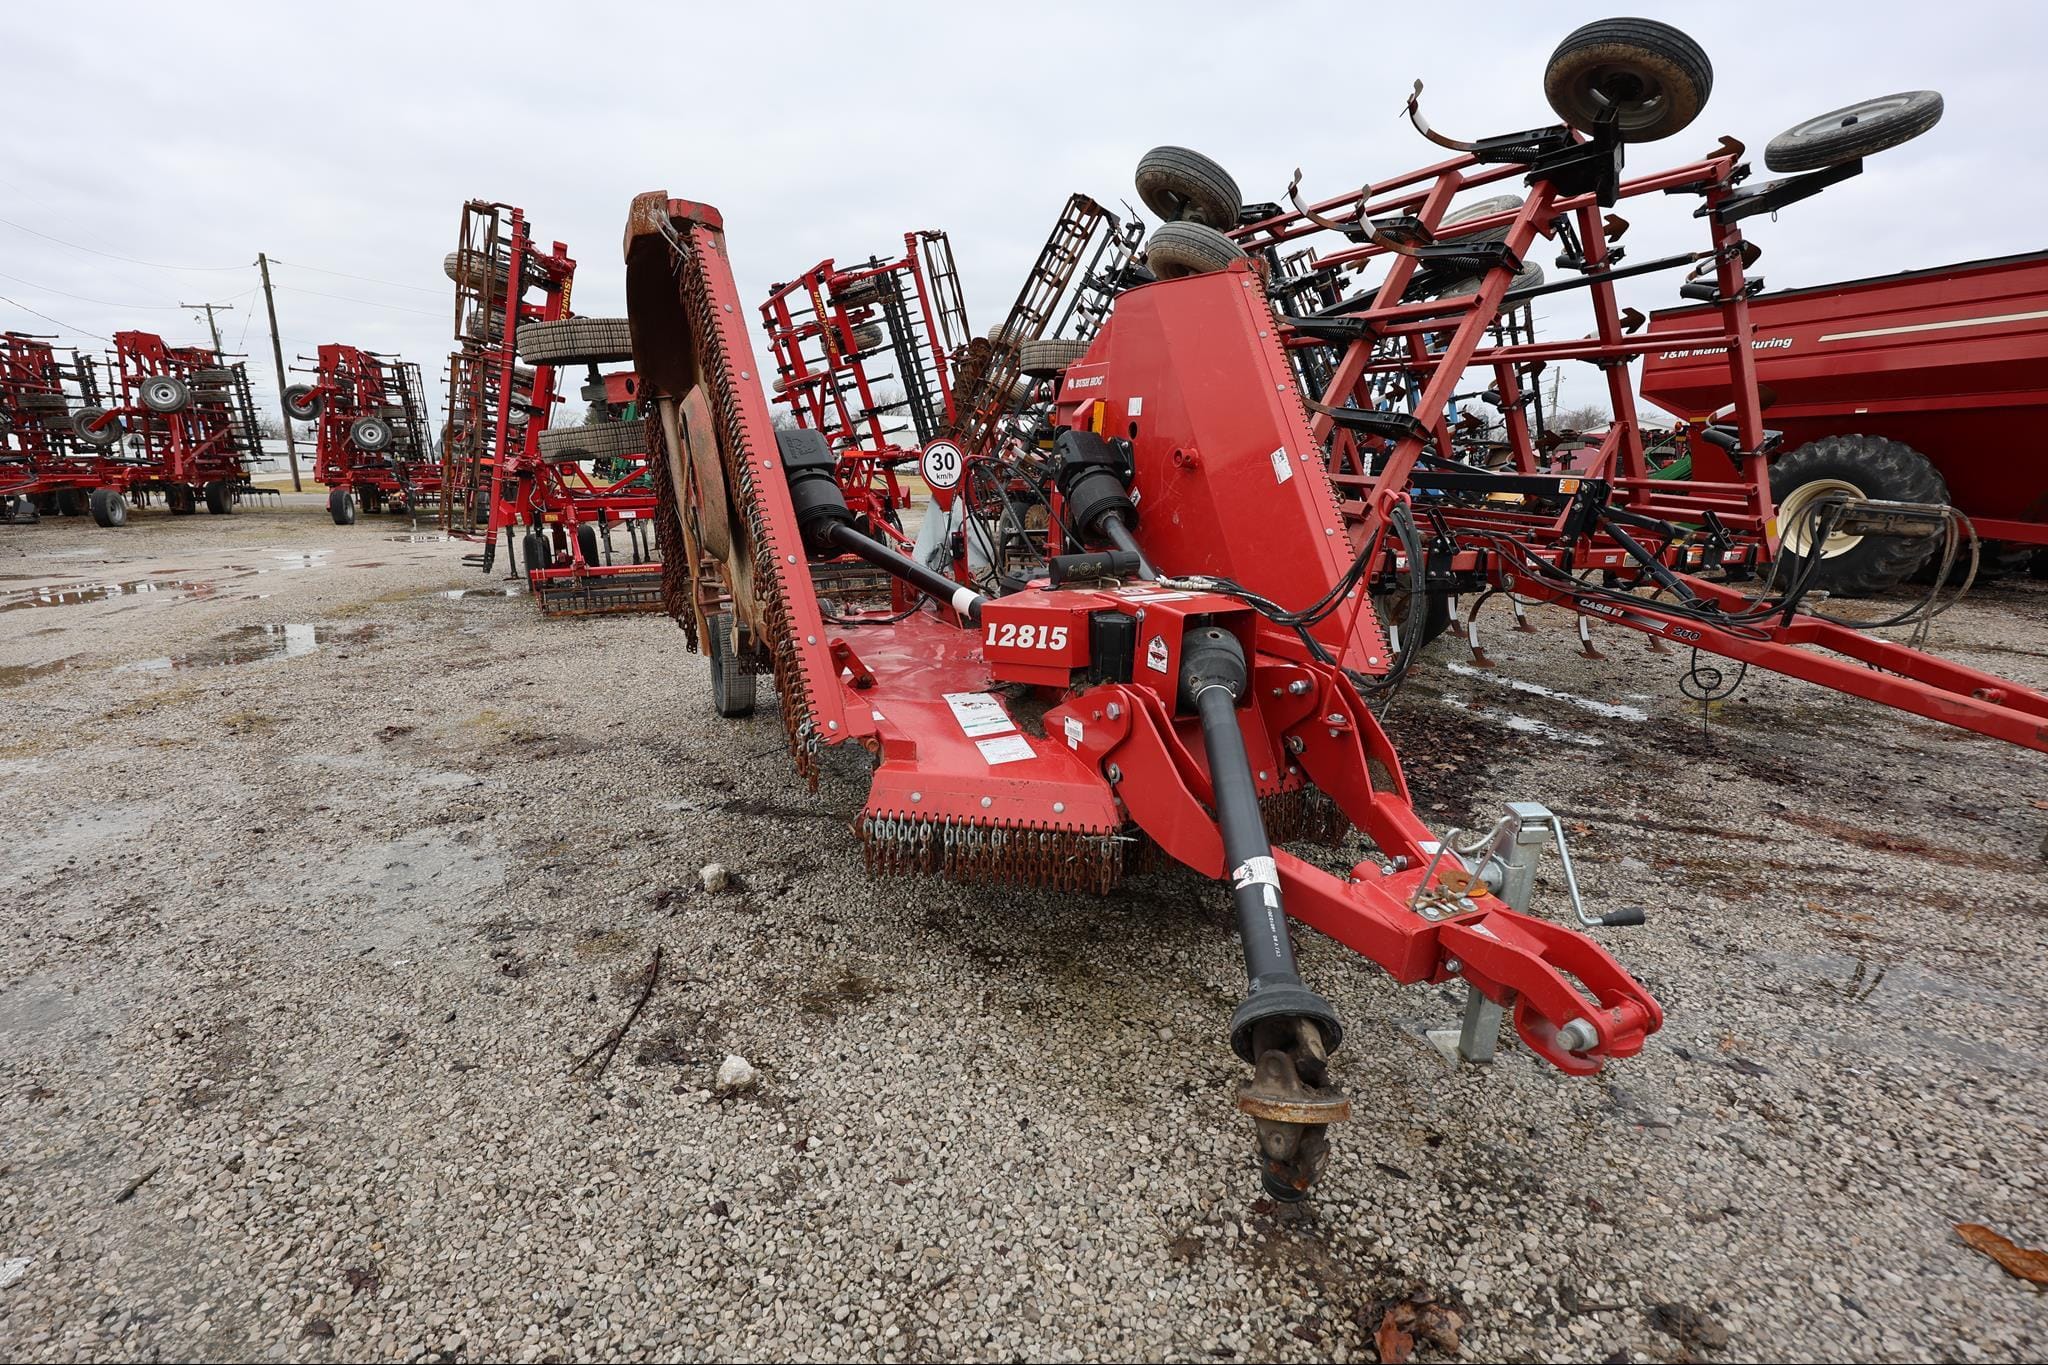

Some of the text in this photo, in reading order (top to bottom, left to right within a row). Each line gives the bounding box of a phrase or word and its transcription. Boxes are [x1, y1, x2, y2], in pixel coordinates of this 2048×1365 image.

[560, 281, 571, 320] SUNFLO
[1692, 337, 1793, 356] Manuturing
[932, 452, 955, 471] 30
[936, 472, 954, 480] km/h
[1580, 599, 1612, 614] CASE
[985, 622, 1068, 650] 12815
